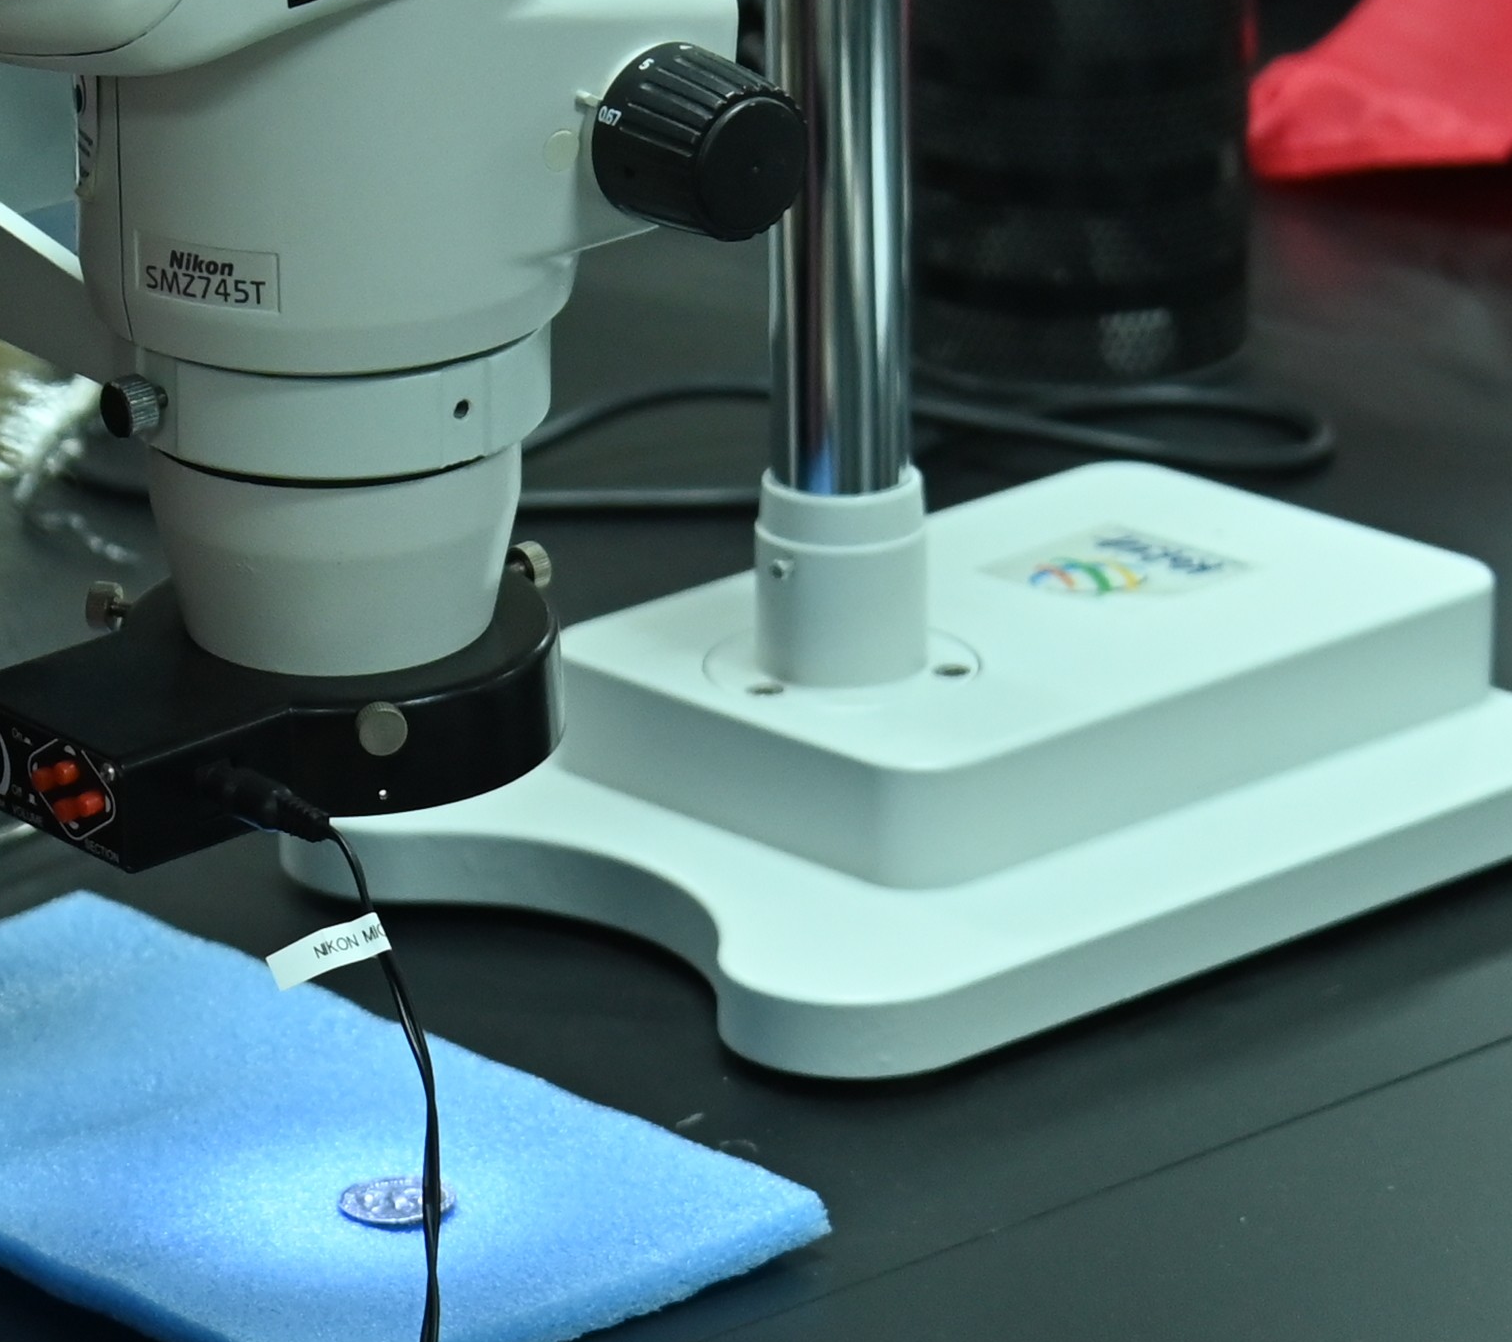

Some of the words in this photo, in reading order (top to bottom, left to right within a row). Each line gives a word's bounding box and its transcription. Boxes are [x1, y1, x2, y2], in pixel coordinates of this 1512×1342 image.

[169, 250, 234, 277] Nikon
[146, 265, 266, 305] SMZ745T
[84, 838, 120, 863] SECTION
[313, 934, 360, 959] NIKON
